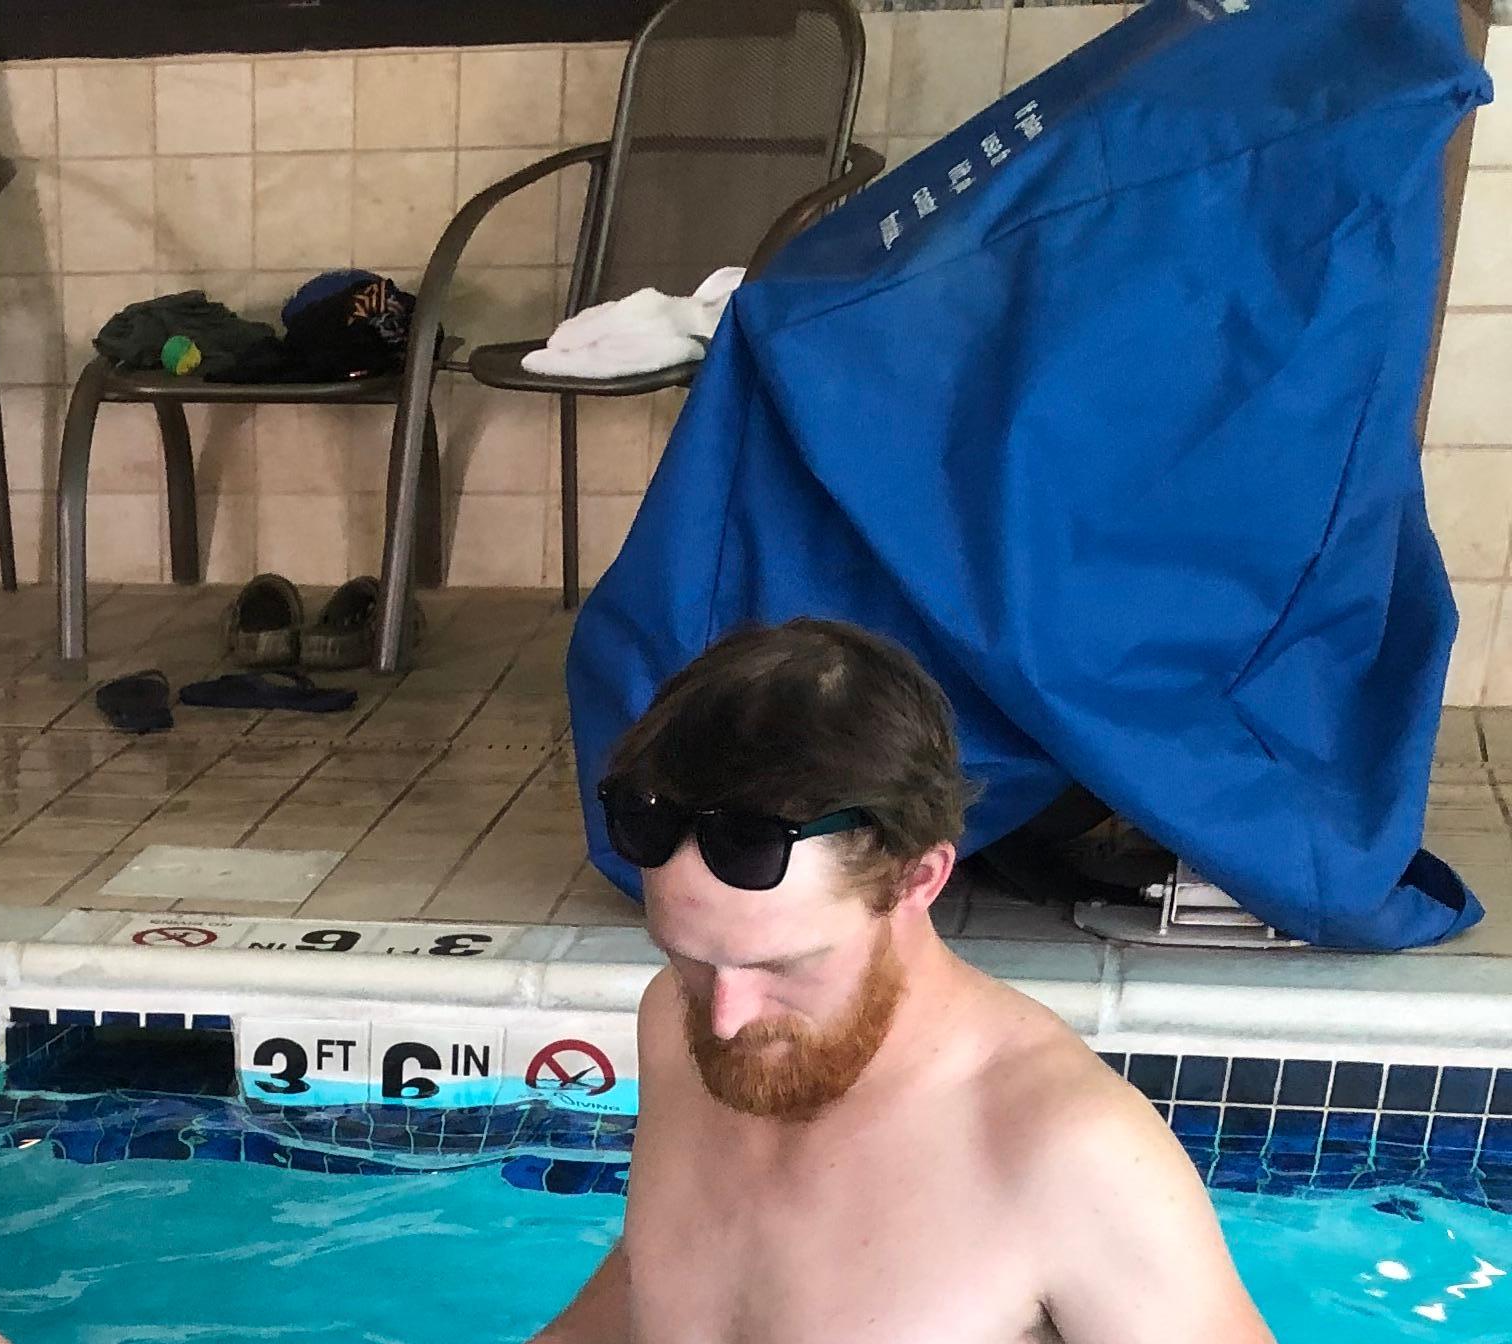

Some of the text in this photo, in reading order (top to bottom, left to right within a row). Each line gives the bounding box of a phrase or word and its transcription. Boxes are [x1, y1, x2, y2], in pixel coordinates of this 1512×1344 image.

[295, 930, 362, 952] 6
[428, 934, 493, 957] 3
[253, 1037, 490, 1100] 3 FT 6 IN
